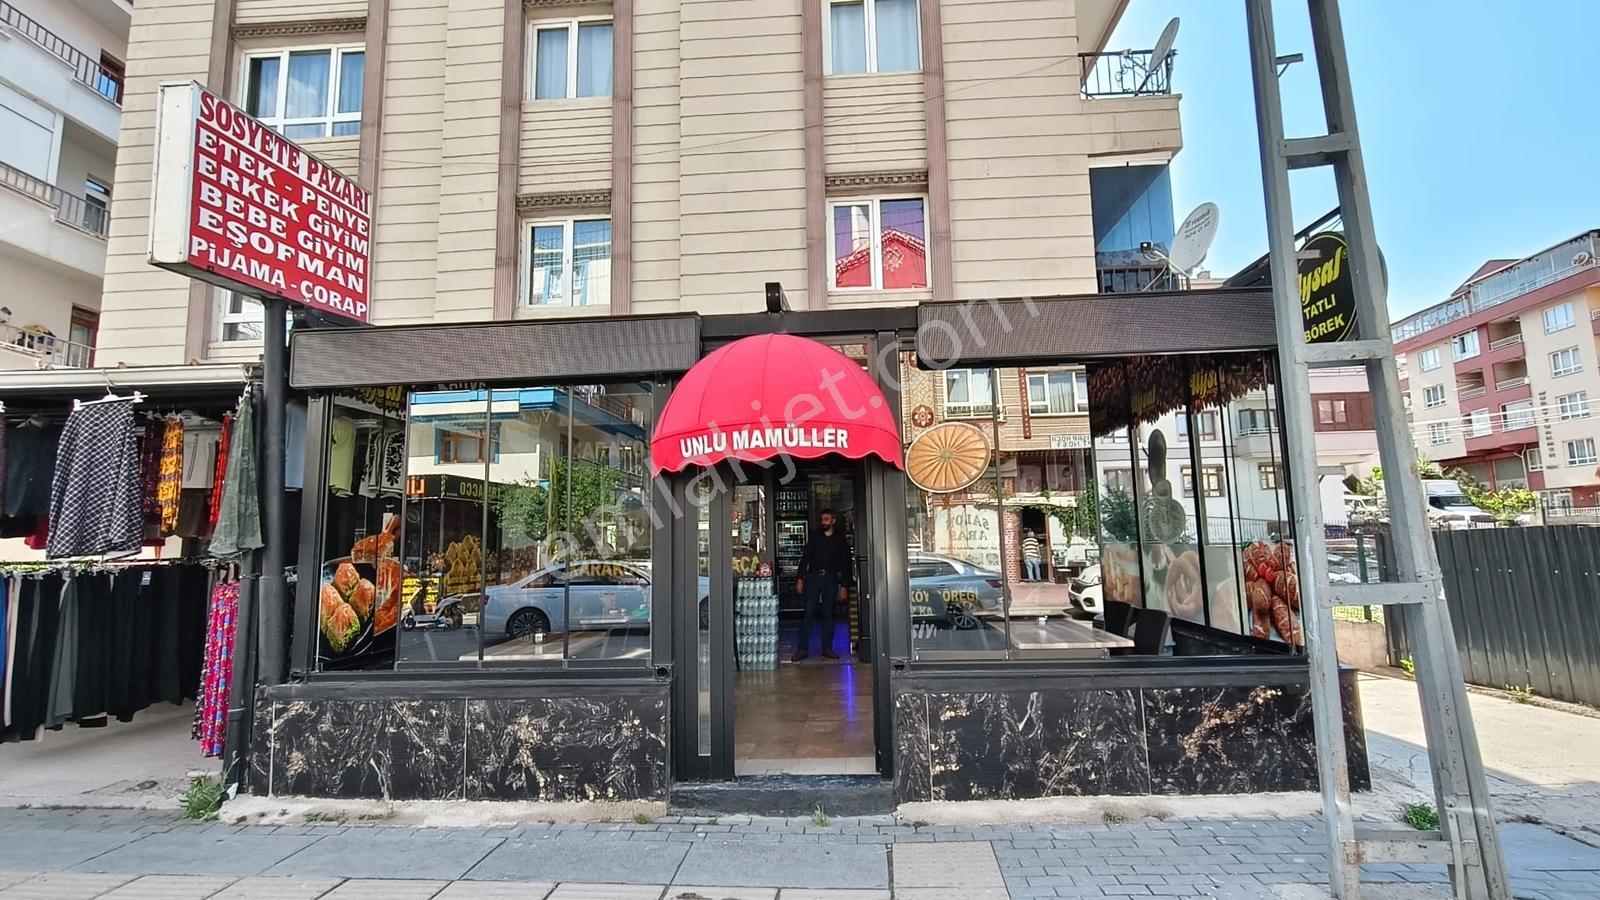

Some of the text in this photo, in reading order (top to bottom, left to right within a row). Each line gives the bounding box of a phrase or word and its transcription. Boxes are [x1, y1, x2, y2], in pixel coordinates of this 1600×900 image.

[199, 127, 276, 188] ETEK
[302, 186, 368, 237] PENYE
[200, 91, 370, 216] SOSYETE PAZARI
[198, 154, 300, 223] ERKEK
[199, 180, 287, 240] BEBE
[198, 206, 364, 294] EŞOFMAN
[300, 280, 367, 318] ÇORAP
[1304, 294, 1336, 320] TATLI
[1304, 313, 1345, 344] BÖREK
[680, 422, 848, 458] UNLU MAMÜLLER
